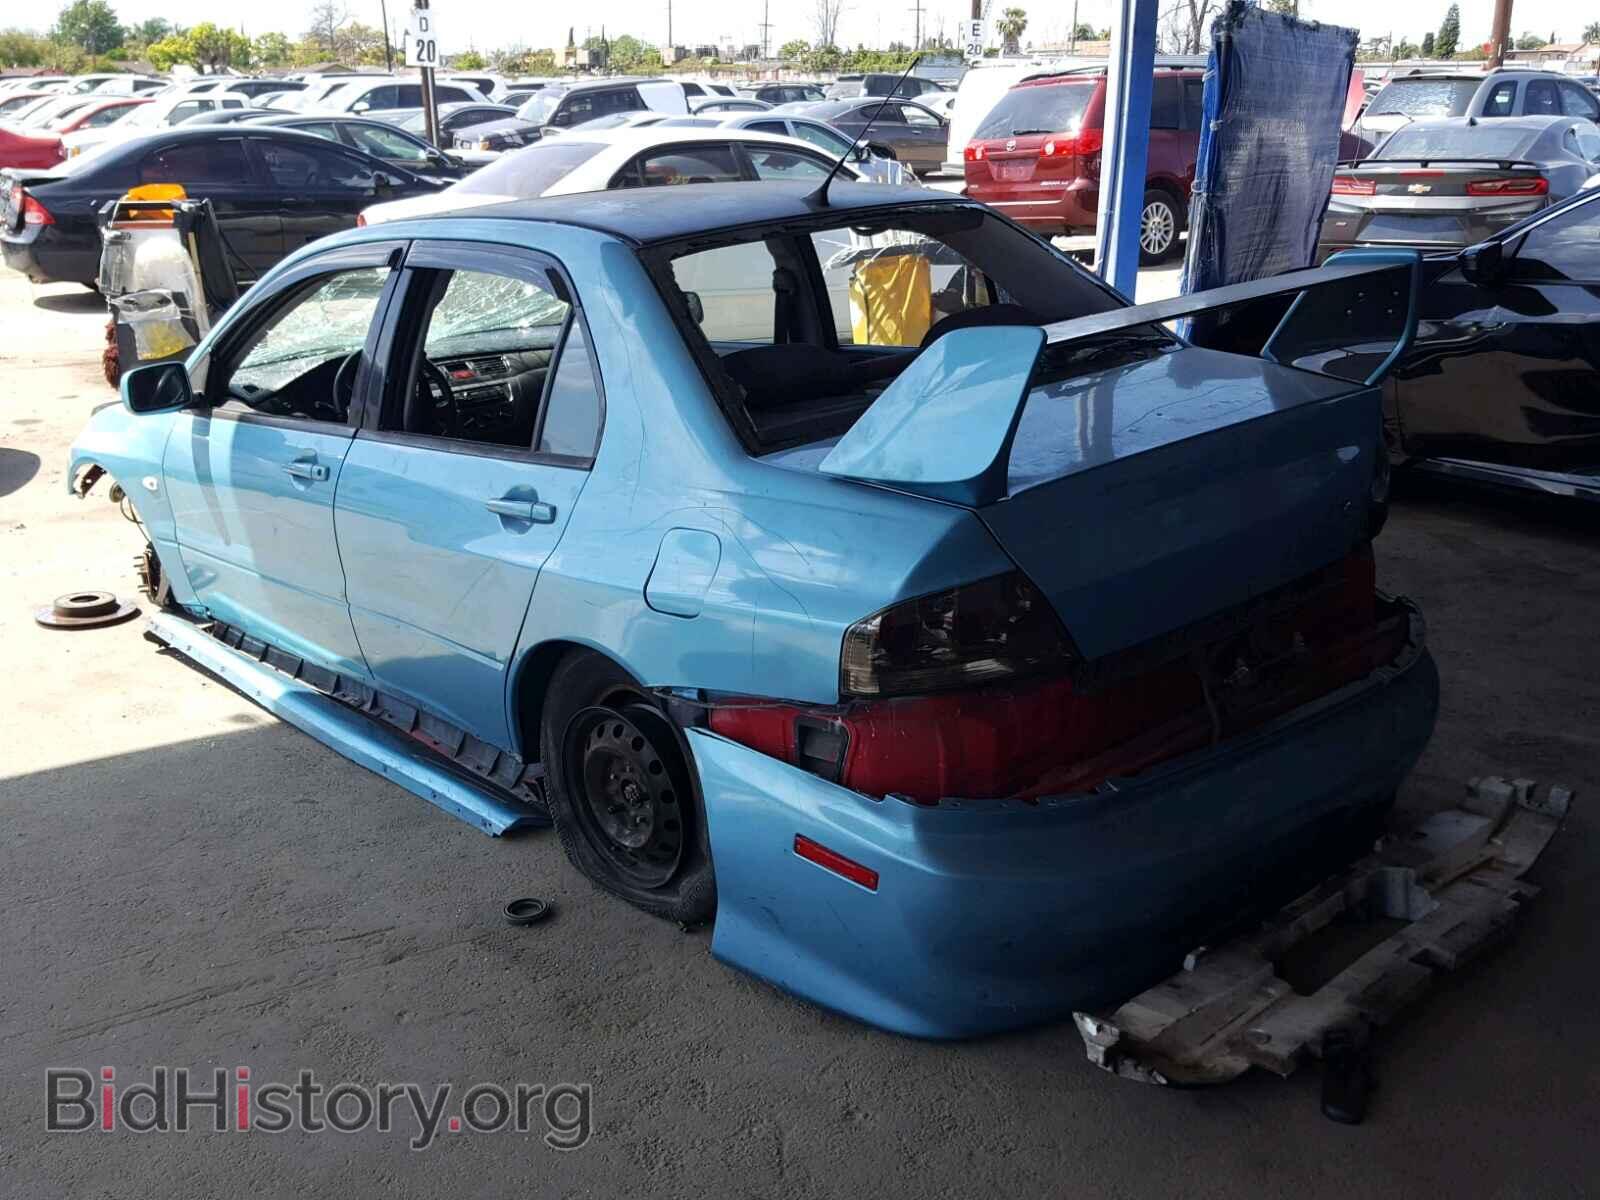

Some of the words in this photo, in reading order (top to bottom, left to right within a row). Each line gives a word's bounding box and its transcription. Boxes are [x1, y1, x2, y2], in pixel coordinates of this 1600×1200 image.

[419, 16, 429, 32] D
[972, 23, 981, 37] E
[416, 39, 436, 63] 20
[967, 43, 982, 56] 20
